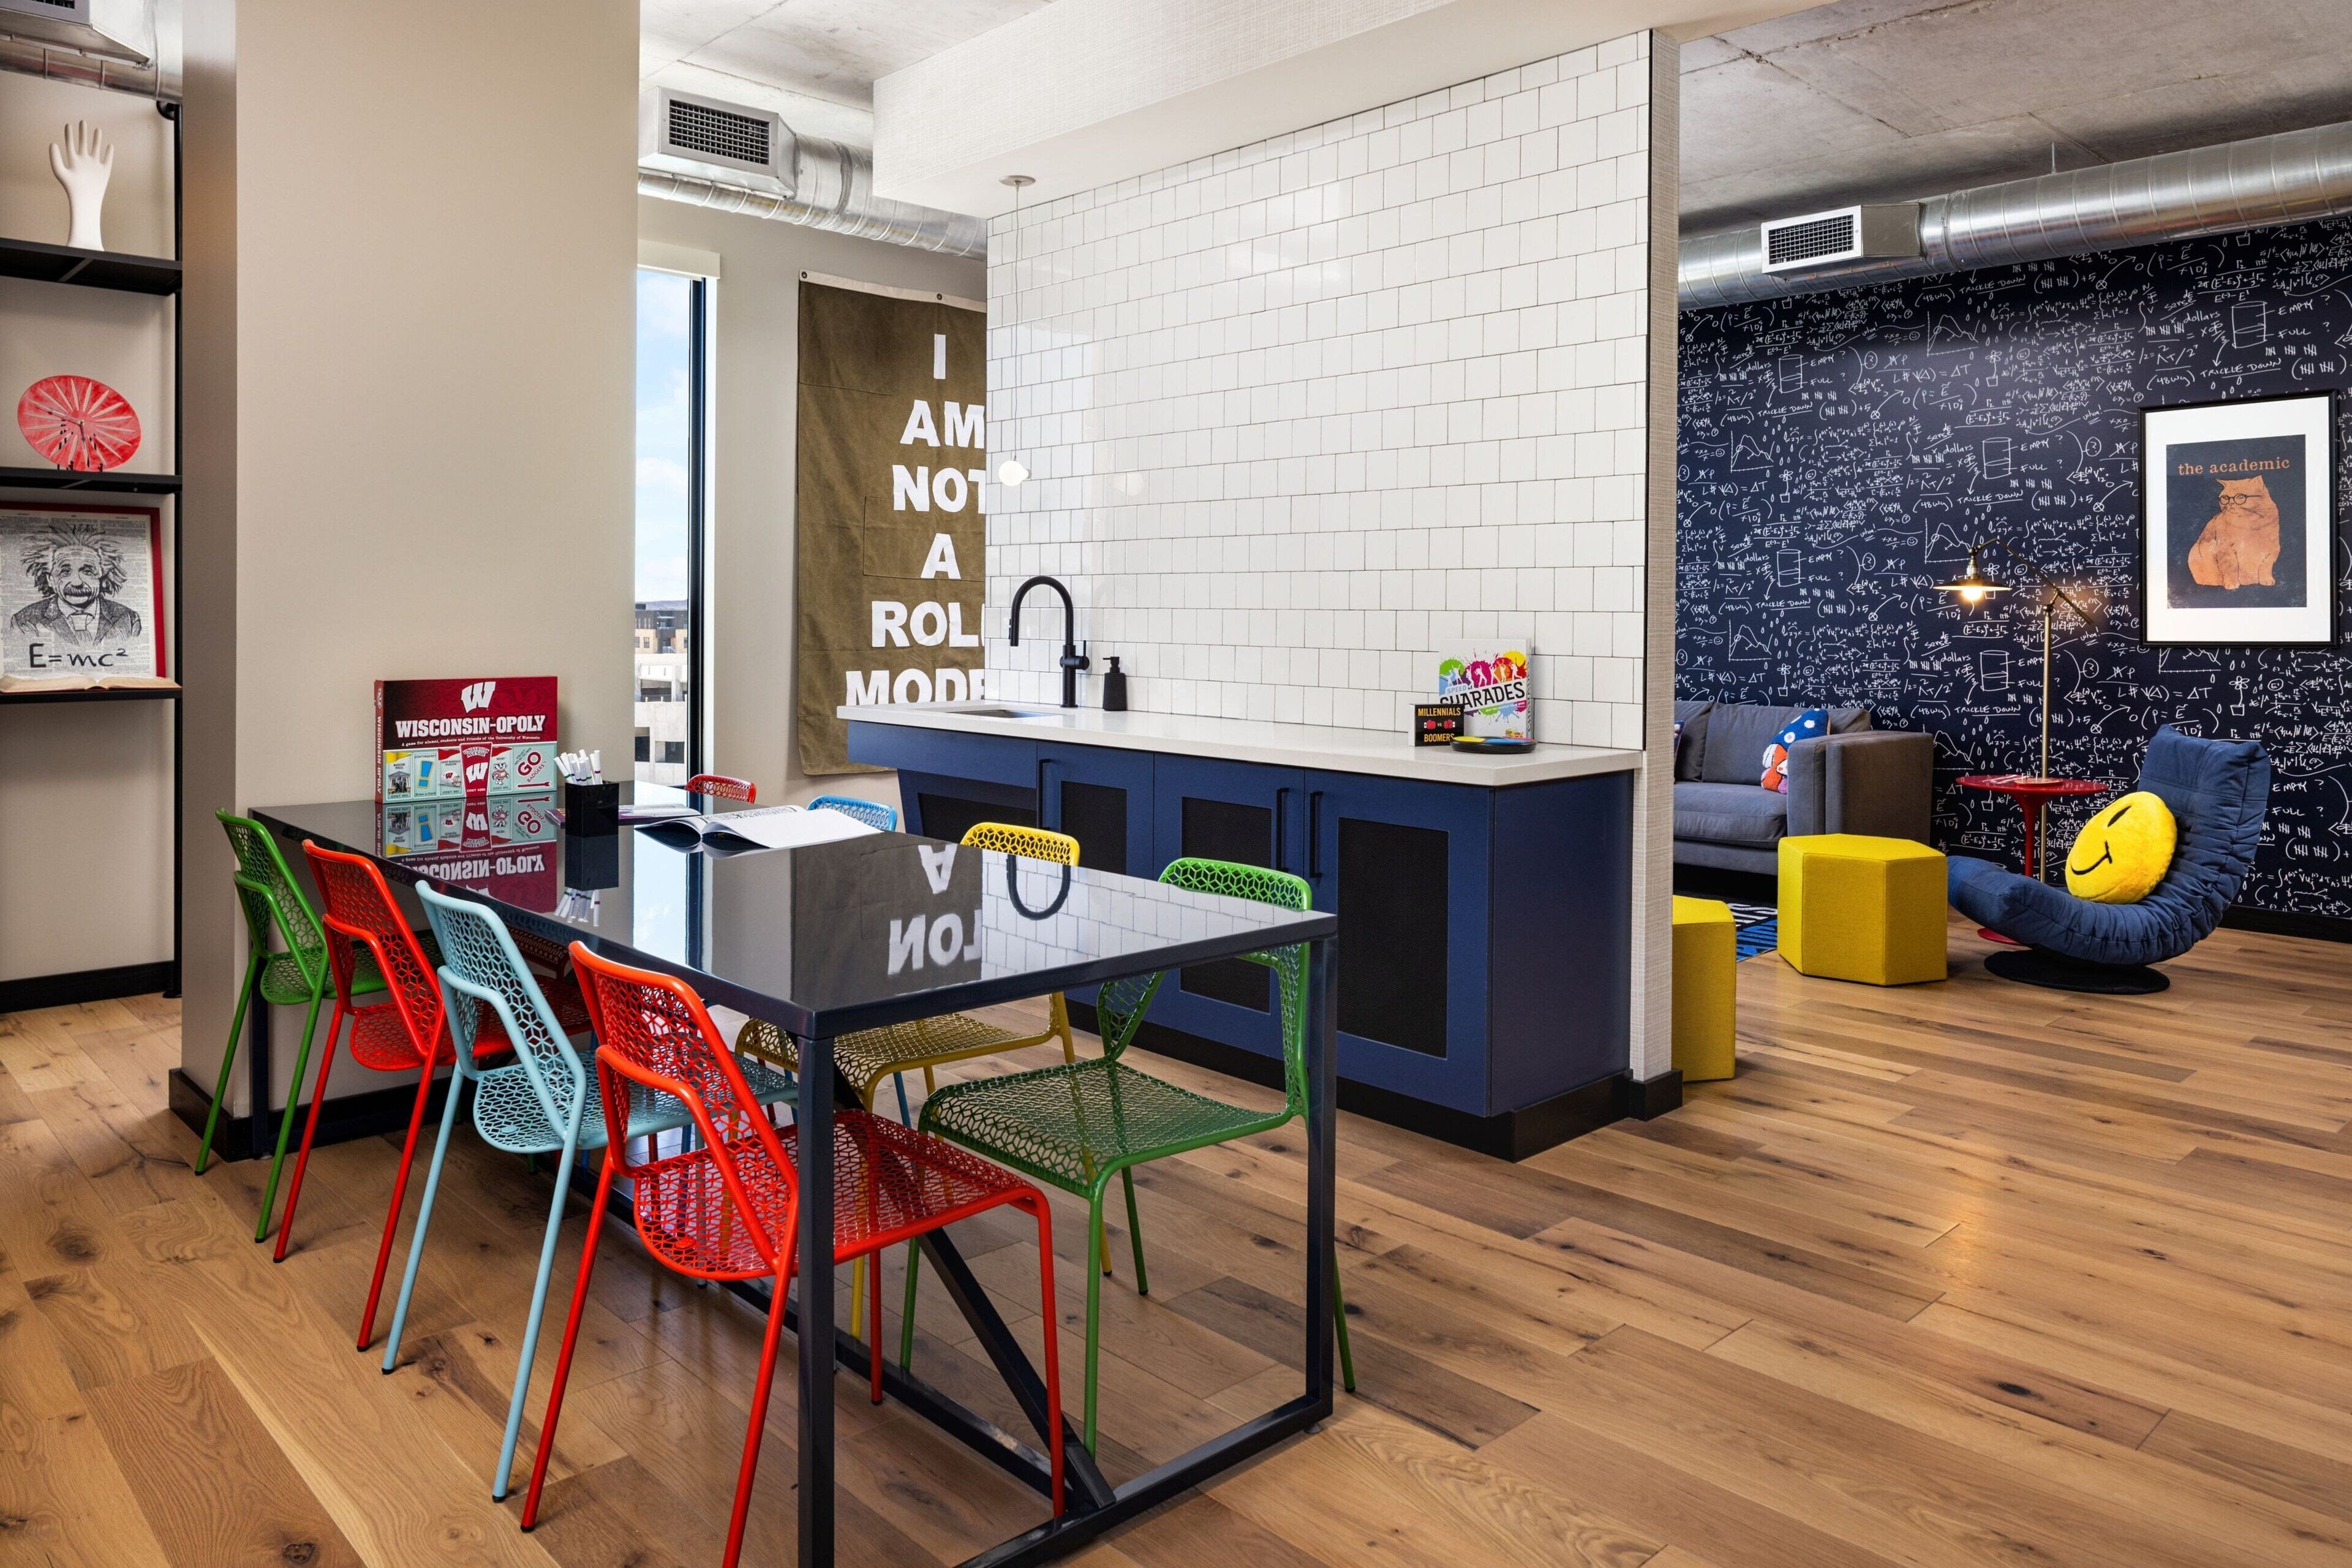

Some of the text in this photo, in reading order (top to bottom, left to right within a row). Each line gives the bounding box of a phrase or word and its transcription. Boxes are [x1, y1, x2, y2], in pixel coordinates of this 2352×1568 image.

[1959, 274, 2026, 294] TRICKLE DOWN
[2278, 299, 2313, 315] EMPTY
[2183, 311, 2220, 323] dollars
[2278, 328, 2311, 338] FULL
[933, 333, 946, 379] I
[1811, 355, 1834, 366] EMPTY
[1746, 361, 1771, 372] dollars
[2200, 358, 2281, 377] TRICKLE DOWN
[1757, 402, 1812, 417] TRICKLE DOWN
[899, 399, 985, 449] AM
[1943, 443, 1973, 454] dollars
[2021, 438, 2049, 452] EMPTY
[2021, 464, 2048, 472] FULL
[2178, 456, 2290, 475] the academic
[1957, 490, 2023, 503] TRICKLE DOWN
[920, 533, 961, 579] A
[1744, 552, 1770, 562] dollars
[1808, 552, 1832, 563] EMPTY
[1755, 598, 1811, 608] TRICKLE DOWN
[872, 601, 985, 647] ROL
[1940, 652, 1971, 662] dollars
[2018, 657, 2044, 666] EMPT
[461, 681, 496, 713] W
[1418, 707, 1461, 717] MILLENNIALS
[1992, 704, 2021, 714] DOWN
[396, 715, 545, 737] WISCONSIN-OPOLY
[518, 752, 541, 776] GO
[466, 762, 489, 783] W
[2272, 781, 2307, 793] EMPTY
[2272, 807, 2305, 816] FULL
